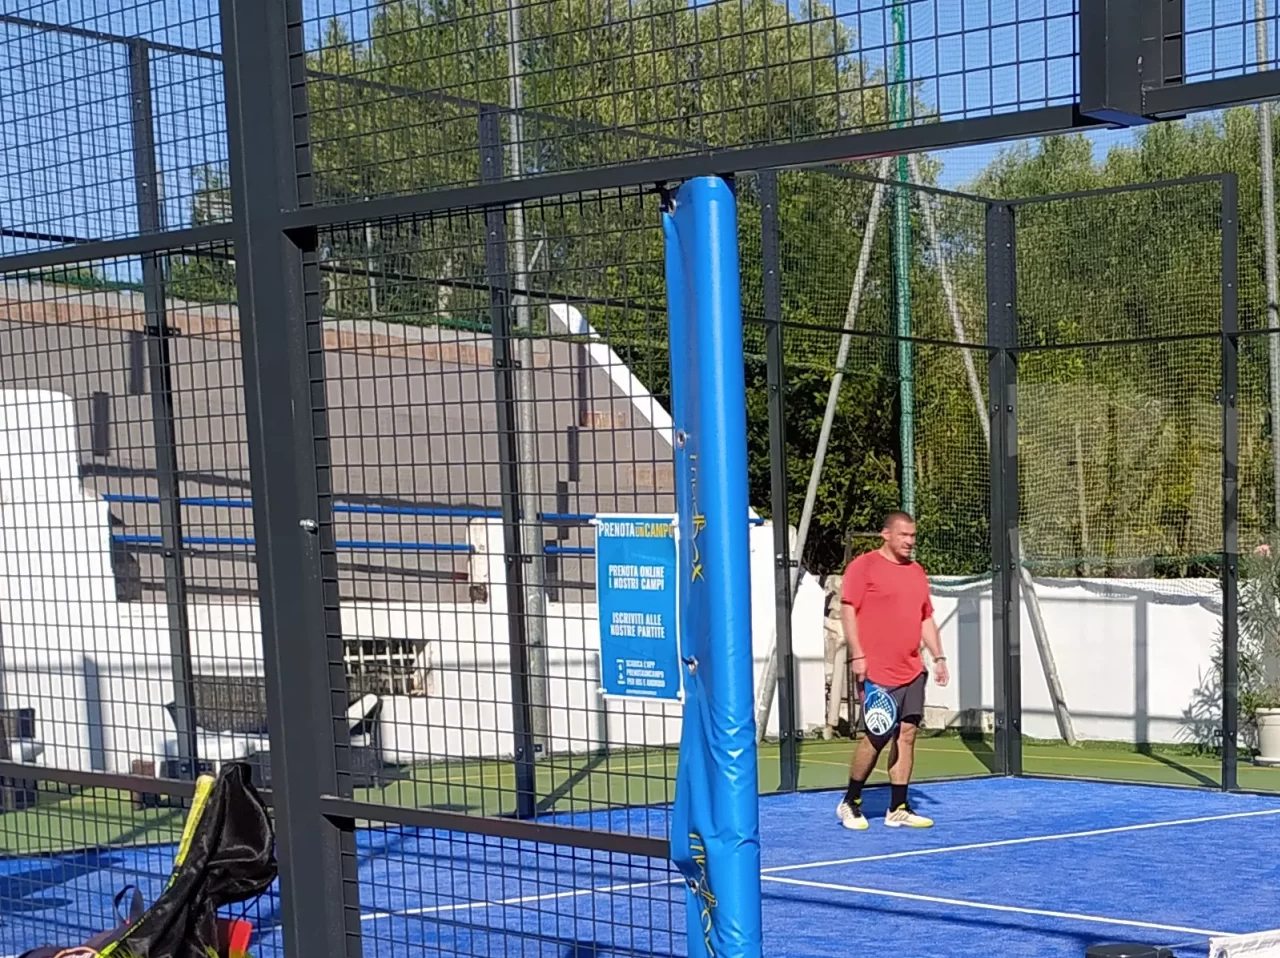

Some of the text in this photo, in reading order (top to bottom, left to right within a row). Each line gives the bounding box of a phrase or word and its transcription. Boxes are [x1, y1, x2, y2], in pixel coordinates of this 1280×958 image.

[609, 565, 665, 578] PRENOTA ONLINE
[614, 578, 639, 589] NOSTRI
[641, 579, 664, 590] CAMPI
[612, 612, 662, 625] ISCRIVITI ALLE
[610, 625, 665, 638] NOSTRE PARTITE
